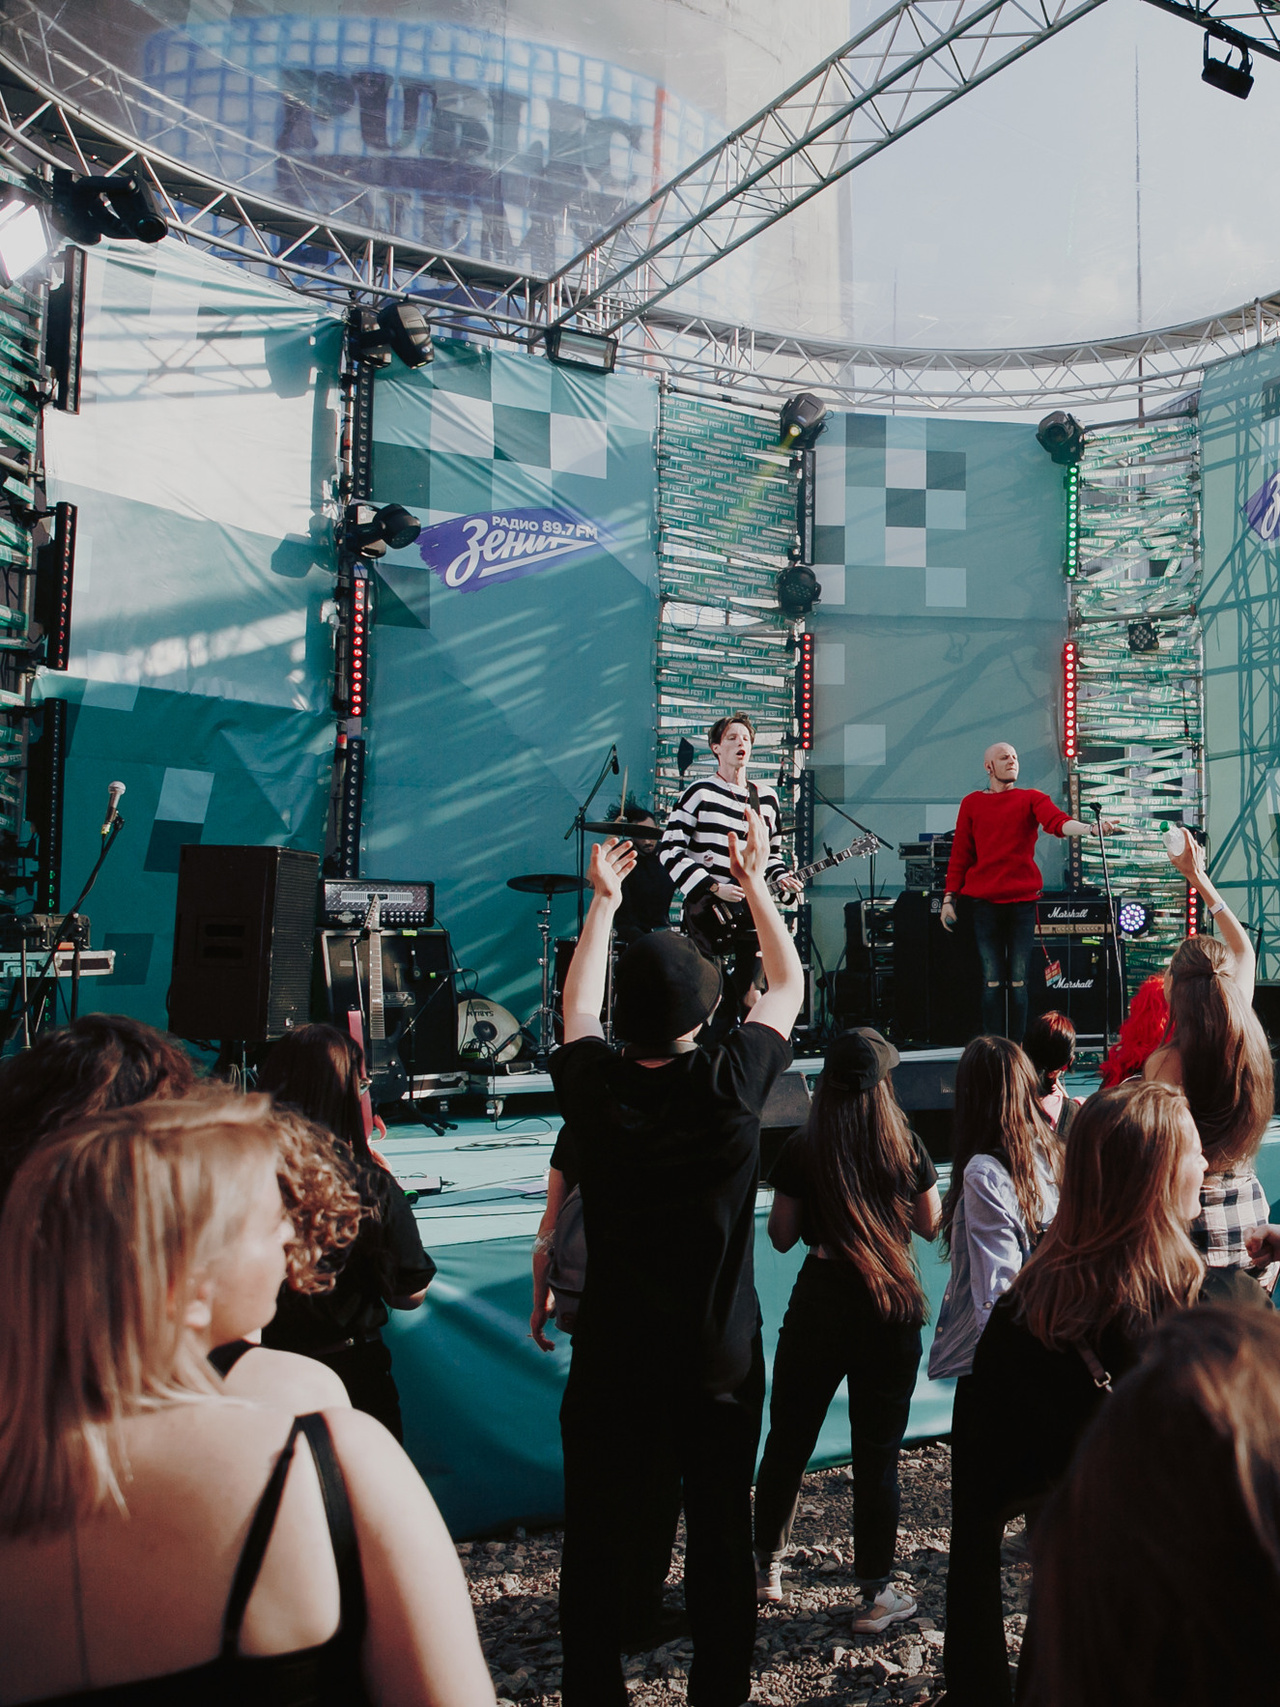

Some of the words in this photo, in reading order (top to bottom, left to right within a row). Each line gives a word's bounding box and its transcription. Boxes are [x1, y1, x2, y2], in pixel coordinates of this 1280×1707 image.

[491, 515, 539, 532] РАДИО
[1047, 907, 1089, 919] Marshall
[1053, 978, 1094, 989] Marshall
